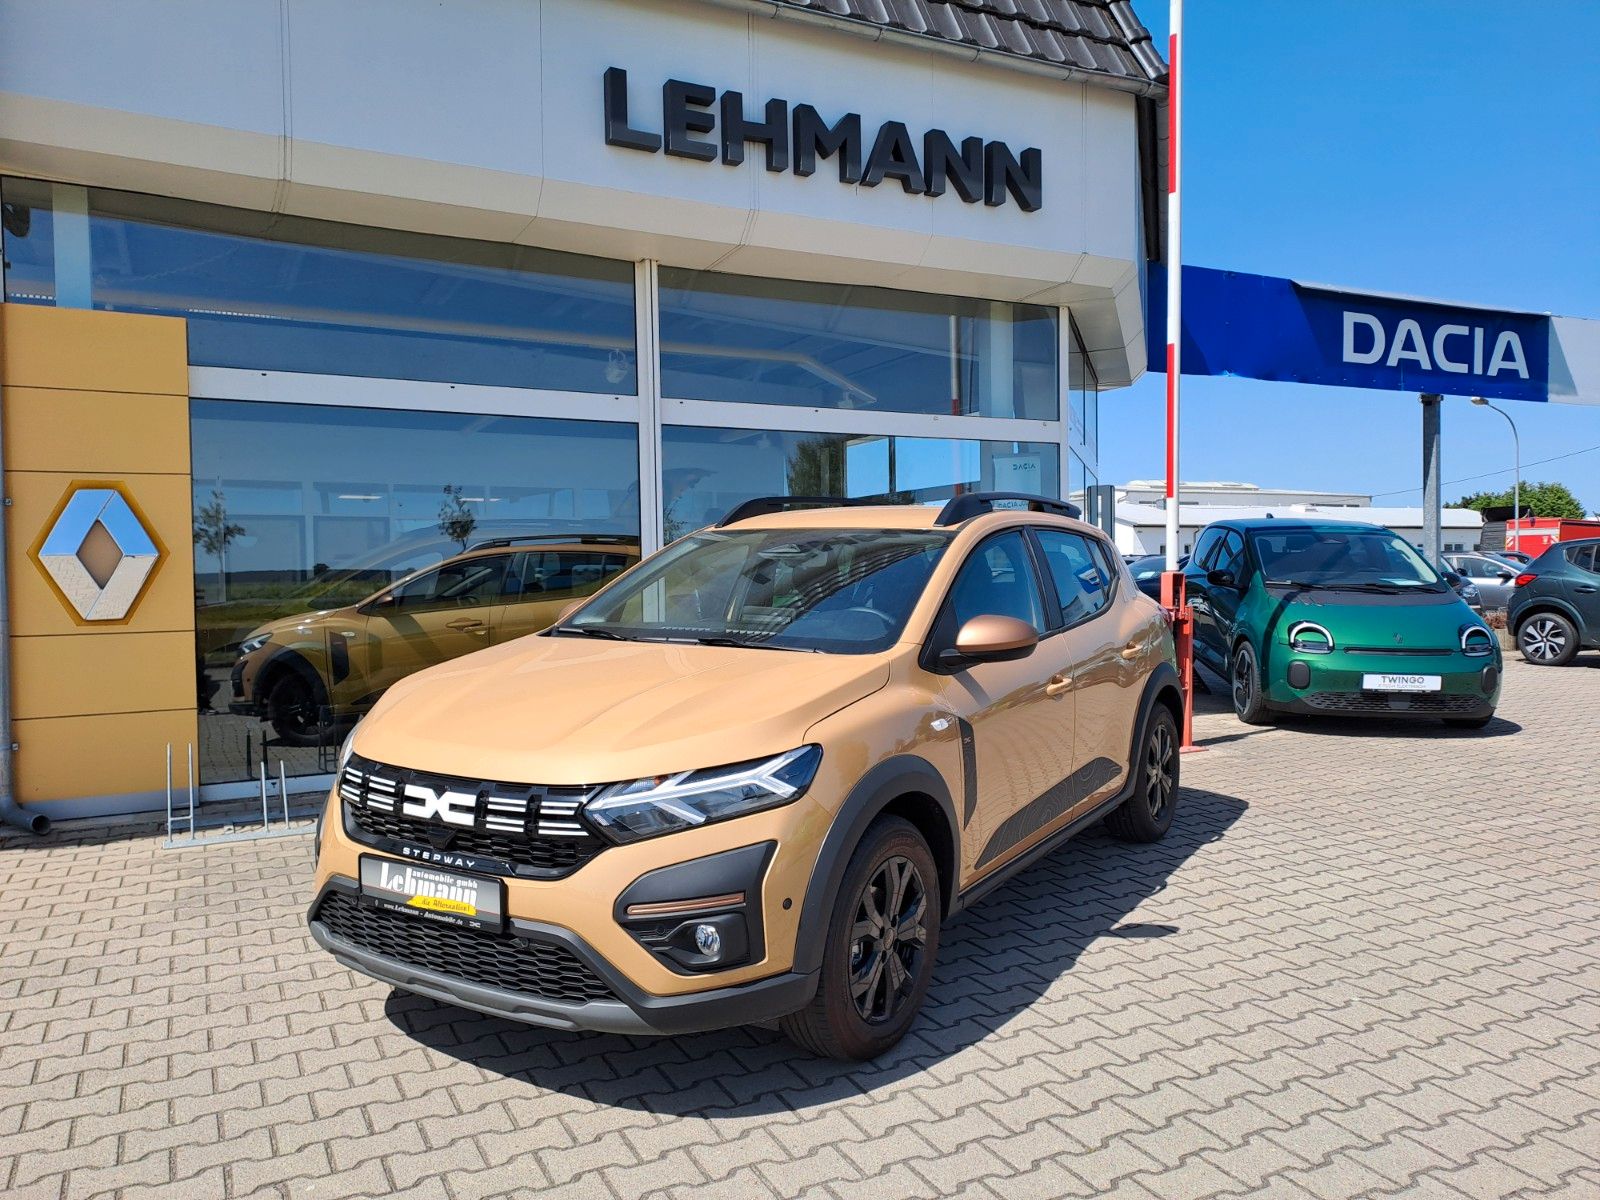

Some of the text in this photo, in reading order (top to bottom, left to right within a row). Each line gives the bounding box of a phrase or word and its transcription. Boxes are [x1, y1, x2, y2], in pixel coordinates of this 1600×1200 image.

[603, 66, 1042, 213] LEHMANN
[1343, 310, 1530, 379] DACIA
[1381, 675, 1425, 684] TWINGO
[403, 847, 475, 867] STEPWAY
[380, 862, 477, 908] Lehmann
[413, 870, 454, 883] automobile
